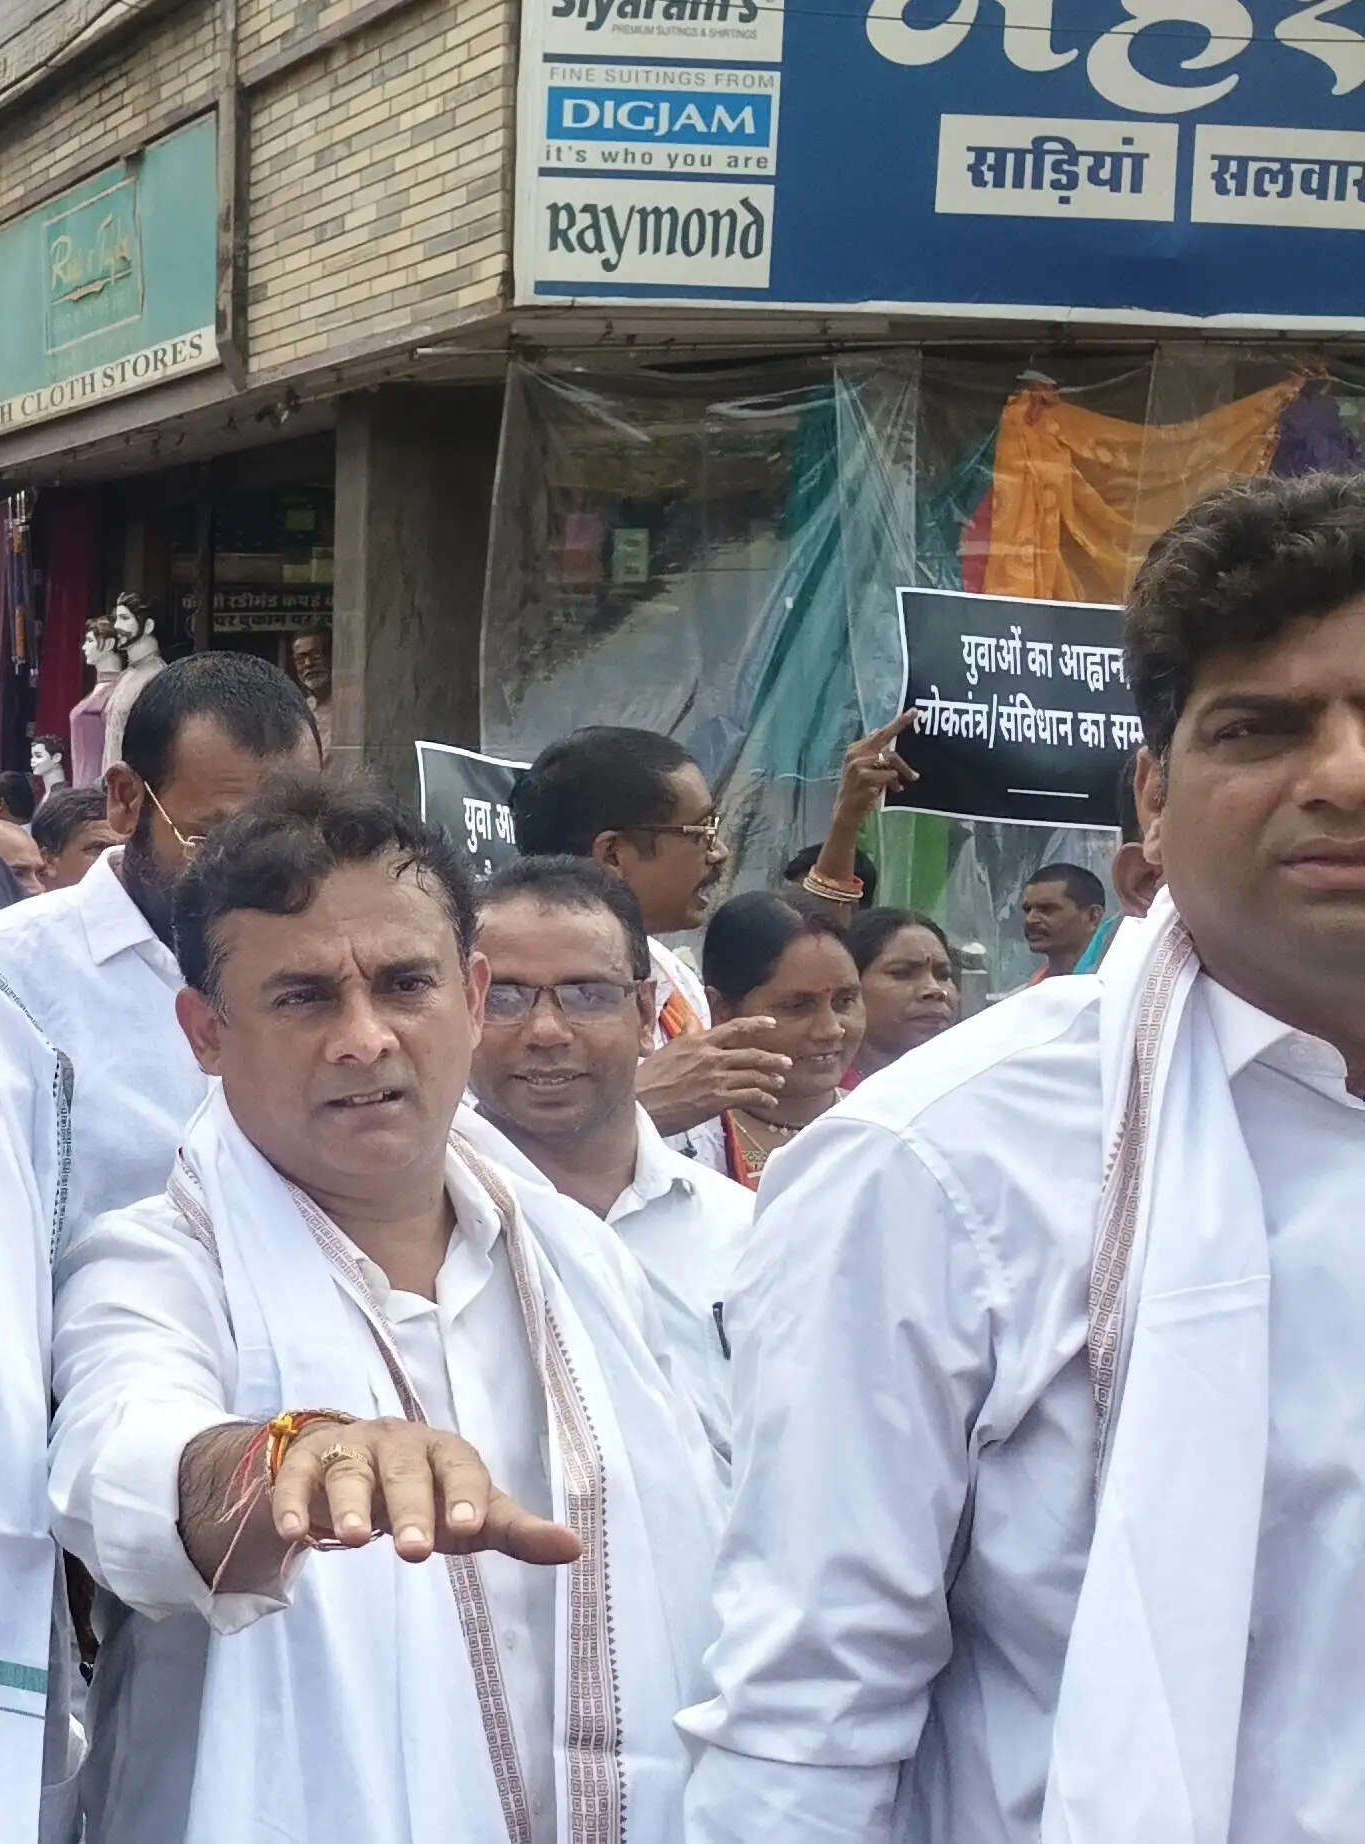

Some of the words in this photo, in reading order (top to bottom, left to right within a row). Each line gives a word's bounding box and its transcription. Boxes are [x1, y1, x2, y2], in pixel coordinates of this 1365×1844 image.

[552, 0, 758, 31] Siyarams
[611, 24, 655, 35] PREMIUM
[657, 26, 699, 37] SUITINGS
[709, 28, 758, 40] SHIRTINGS
[549, 67, 596, 83] FINE
[605, 69, 706, 86] SUITINGS
[715, 73, 775, 89] FROM
[562, 98, 756, 137] DIGJAM
[545, 144, 587, 163] it's
[601, 148, 653, 166] who
[667, 152, 712, 169] you
[726, 154, 769, 169] are
[965, 136, 1149, 205] साड़ियां
[546, 196, 765, 273] Raymond
[20, 374, 96, 416] CLOTH
[101, 334, 203, 389] STORES
[961, 626, 1023, 685] युवाओं
[1026, 641, 1054, 678] का
[1078, 712, 1107, 749] का
[462, 797, 492, 853] युवा
